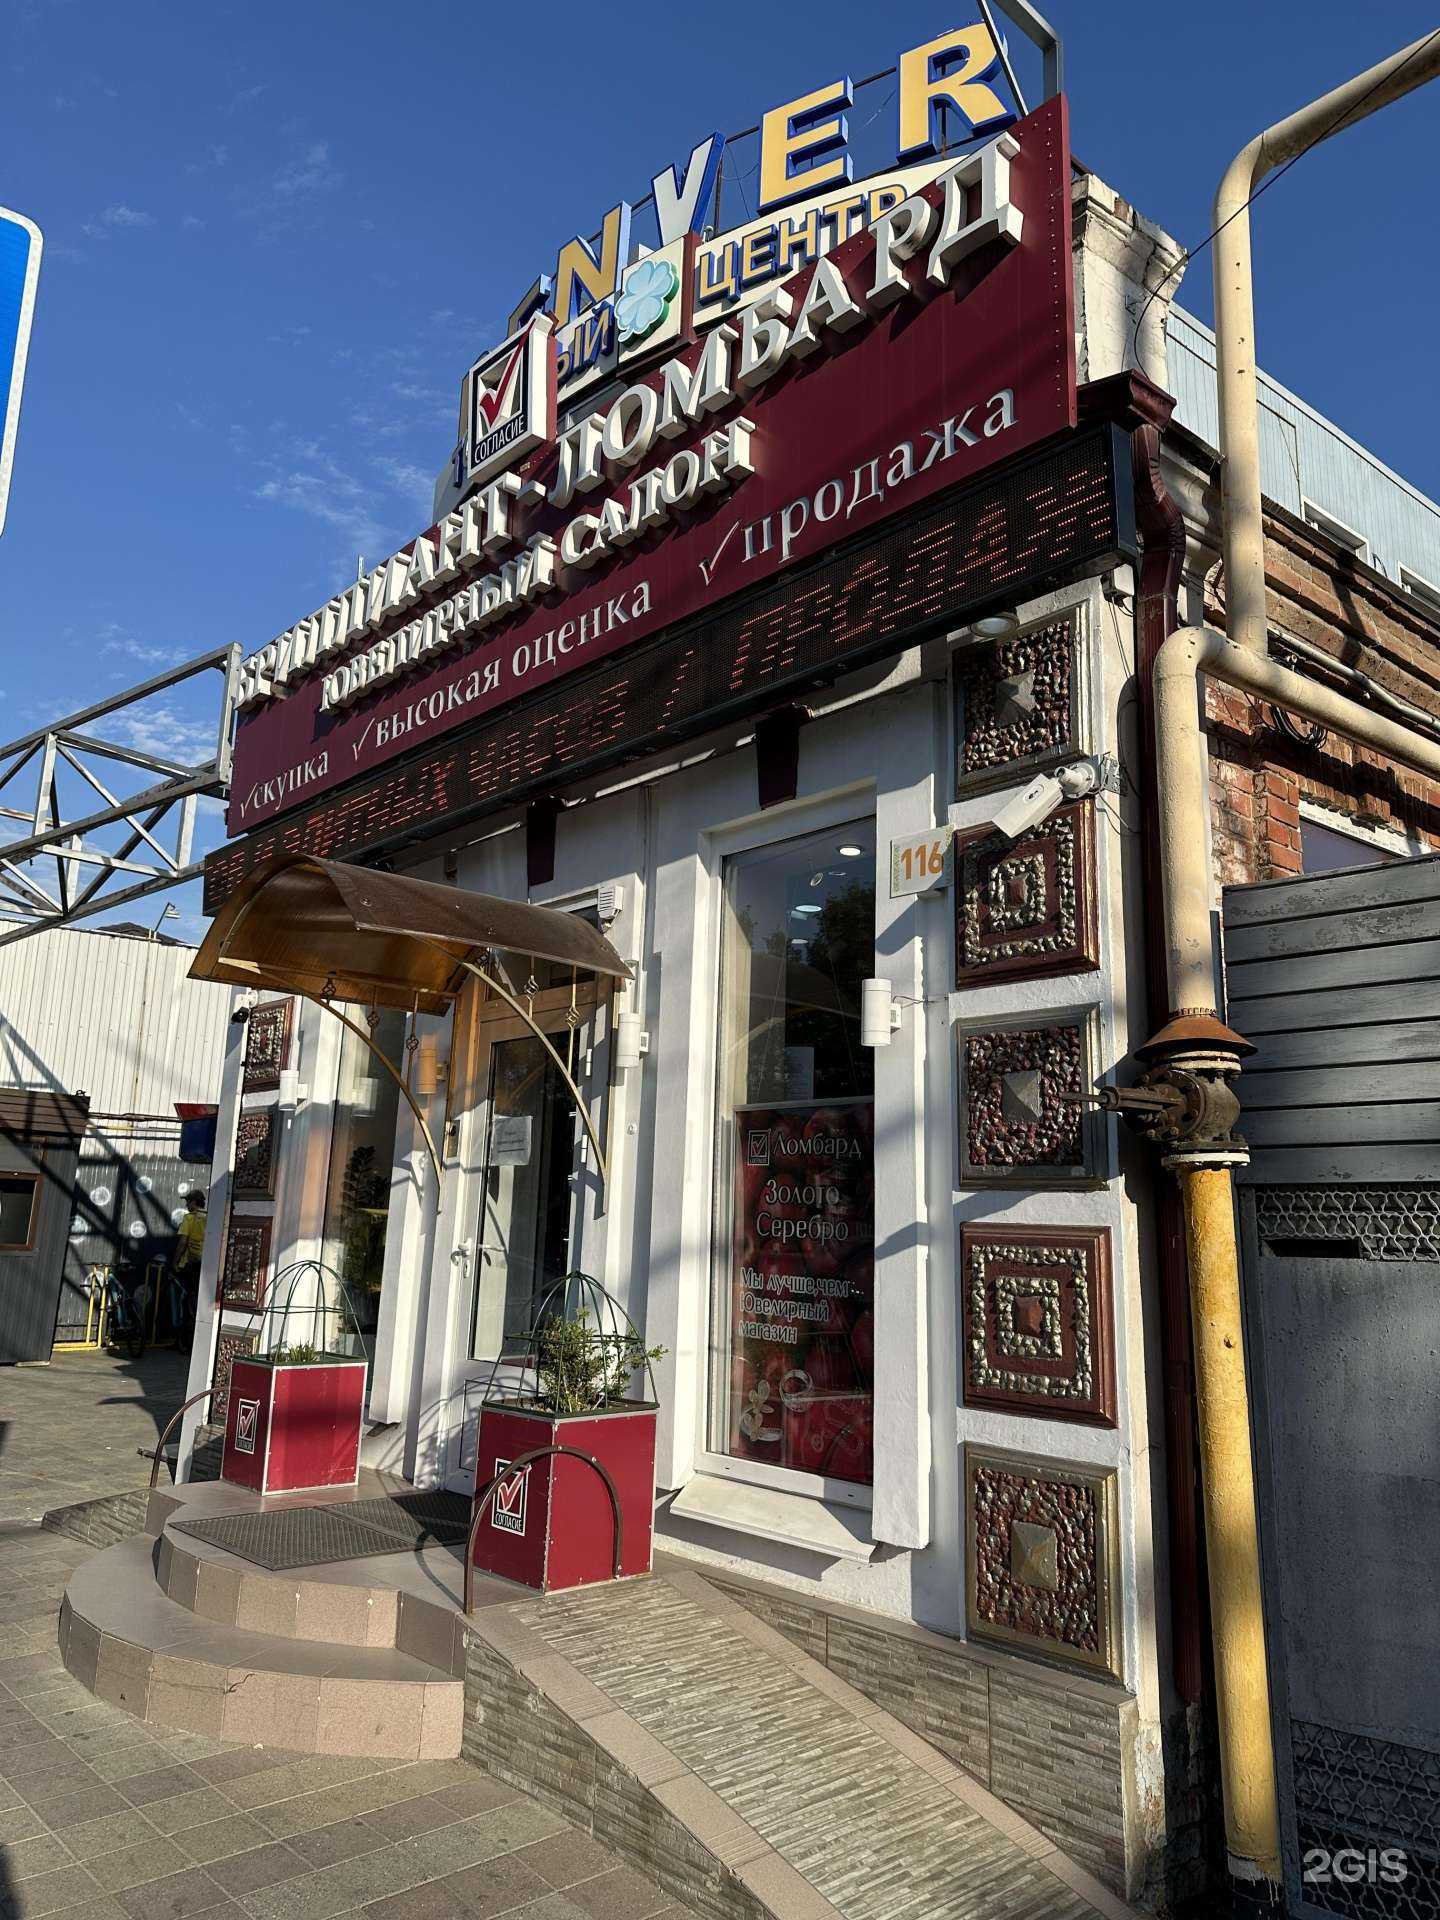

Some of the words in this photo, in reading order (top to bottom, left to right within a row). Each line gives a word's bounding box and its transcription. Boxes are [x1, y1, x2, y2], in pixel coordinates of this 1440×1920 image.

[235, 131, 1024, 712] БРИЛЛИАНТ-ЛОМБАРД
[474, 414, 525, 464] СОГЛАСИЕ
[741, 389, 1018, 564] продажа
[319, 532, 556, 715] ЮВЕЛИРНЫЙ
[560, 417, 757, 569] САЛОН
[375, 656, 501, 749] высокая
[511, 579, 652, 678] оценка
[253, 750, 329, 811] скупка
[900, 839, 945, 881] 116
[772, 1132, 862, 1160] Ломбард
[765, 1179, 840, 1206] Золото
[756, 1212, 849, 1246] Серебро
[740, 1267, 764, 1291] Мы
[739, 1290, 830, 1322] Ювелирный
[738, 1320, 798, 1345] магазин
[494, 1512, 522, 1531] СОГЛАСИЕ
